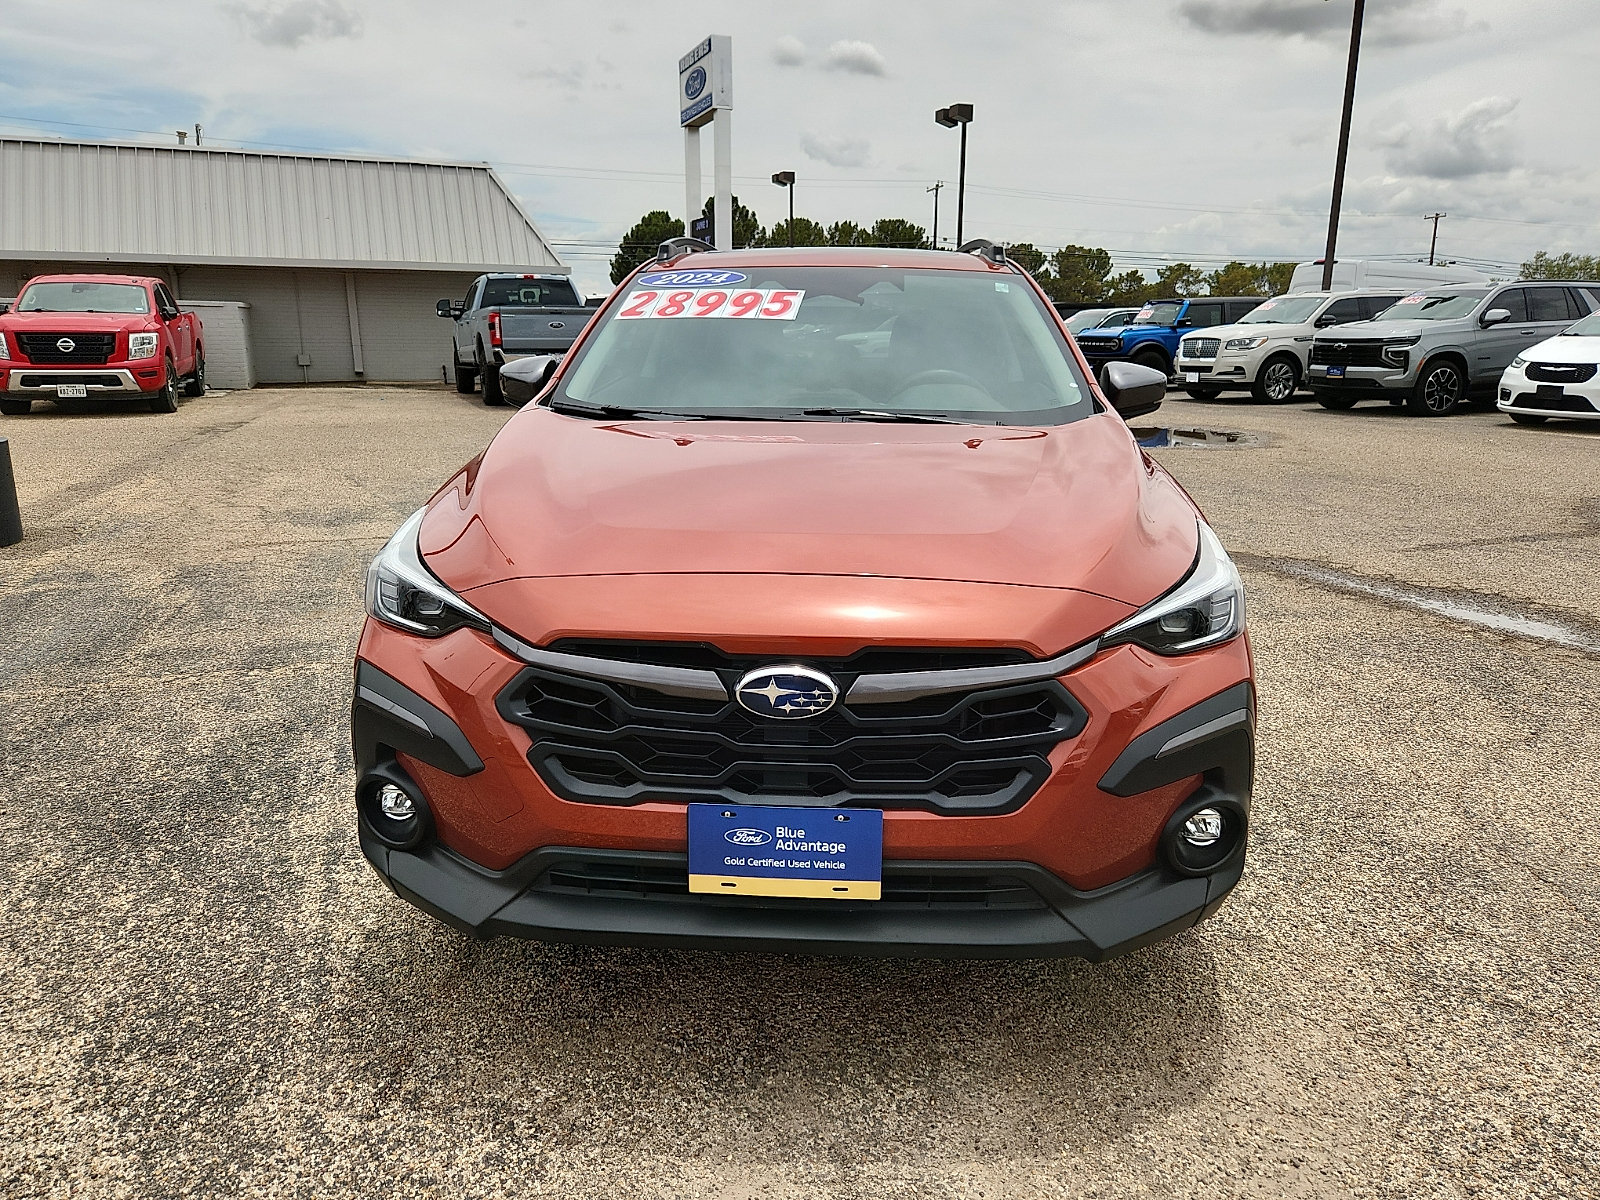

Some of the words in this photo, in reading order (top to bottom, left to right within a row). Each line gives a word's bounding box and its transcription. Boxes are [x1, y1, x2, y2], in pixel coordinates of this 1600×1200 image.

[679, 39, 709, 74] ROGERS
[652, 272, 732, 285] 2024
[620, 291, 800, 317] 28995
[775, 826, 806, 839] Blue
[775, 839, 846, 854] Advantage
[724, 856, 745, 866] Gold
[747, 857, 785, 868] Certified
[787, 859, 811, 869] Used
[813, 860, 846, 870] Vehicle
